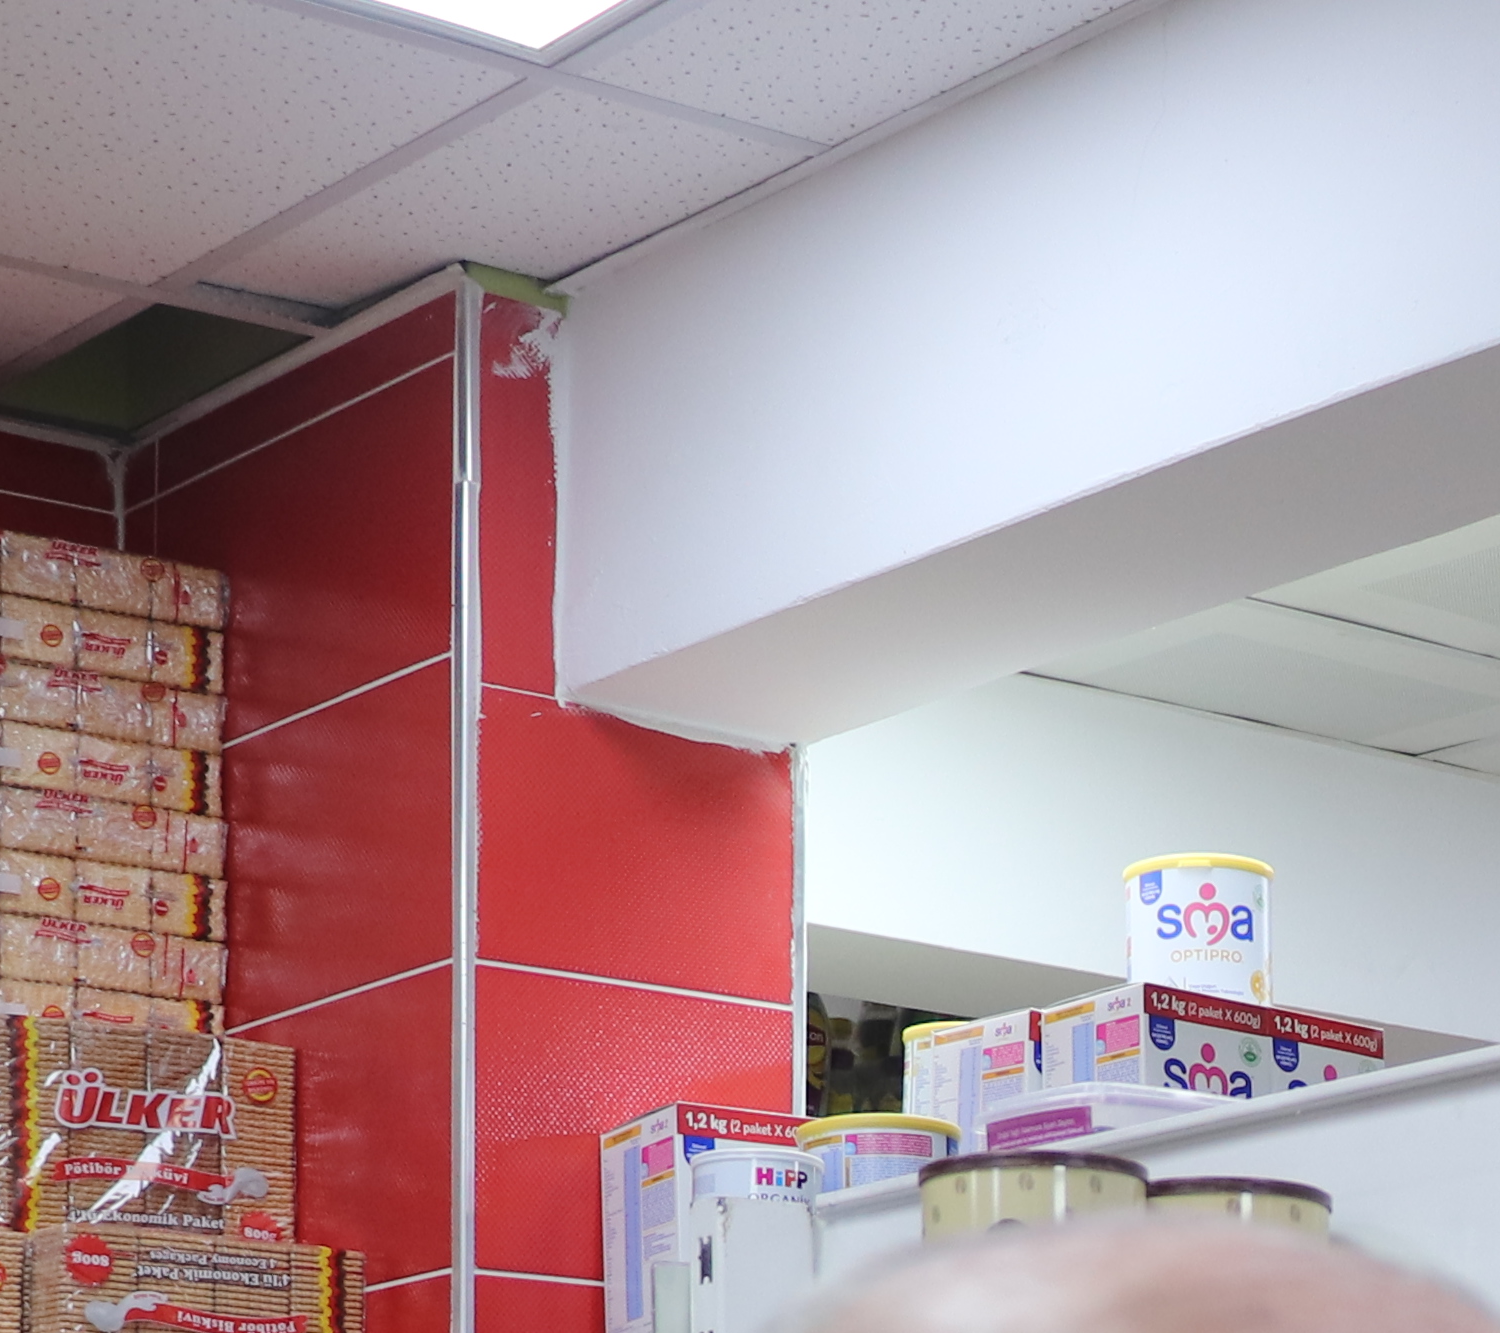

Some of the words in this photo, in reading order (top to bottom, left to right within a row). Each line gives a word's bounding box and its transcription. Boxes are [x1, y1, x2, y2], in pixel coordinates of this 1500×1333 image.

[1157, 893, 1254, 946] sma
[1171, 949, 1243, 963] OPTIPRO
[1150, 991, 1170, 1010] 1,2
[1171, 996, 1186, 1016] kg
[1187, 1002, 1197, 1017] (2
[1198, 1004, 1223, 1023] paket
[1233, 1008, 1261, 1030] 600g)
[1274, 1016, 1292, 1033] 1,2
[1294, 1019, 1308, 1039] kg
[1310, 1025, 1319, 1039] (2
[1320, 1027, 1343, 1043] paket
[1353, 1031, 1378, 1052] 600g)
[55, 1068, 236, 1139] ÜLKER
[685, 1111, 708, 1128] 1,2
[710, 1117, 727, 1134] kg
[730, 1120, 741, 1134] (2
[743, 1122, 772, 1136] paket
[774, 1126, 783, 1136] X
[64, 1160, 121, 1176] Pötibör
[126, 1164, 189, 1184] Bküvi
[756, 1167, 808, 1190] HiPP
[105, 1209, 179, 1225] Ekonomik
[183, 1213, 225, 1230] Paket
[72, 1251, 110, 1267] 800g
[151, 1251, 207, 1265] Packages
[212, 1254, 266, 1269] Economy
[137, 1265, 179, 1280] Paket
[184, 1269, 259, 1286] Ekonomik
[177, 1311, 235, 1332] Bisküvi
